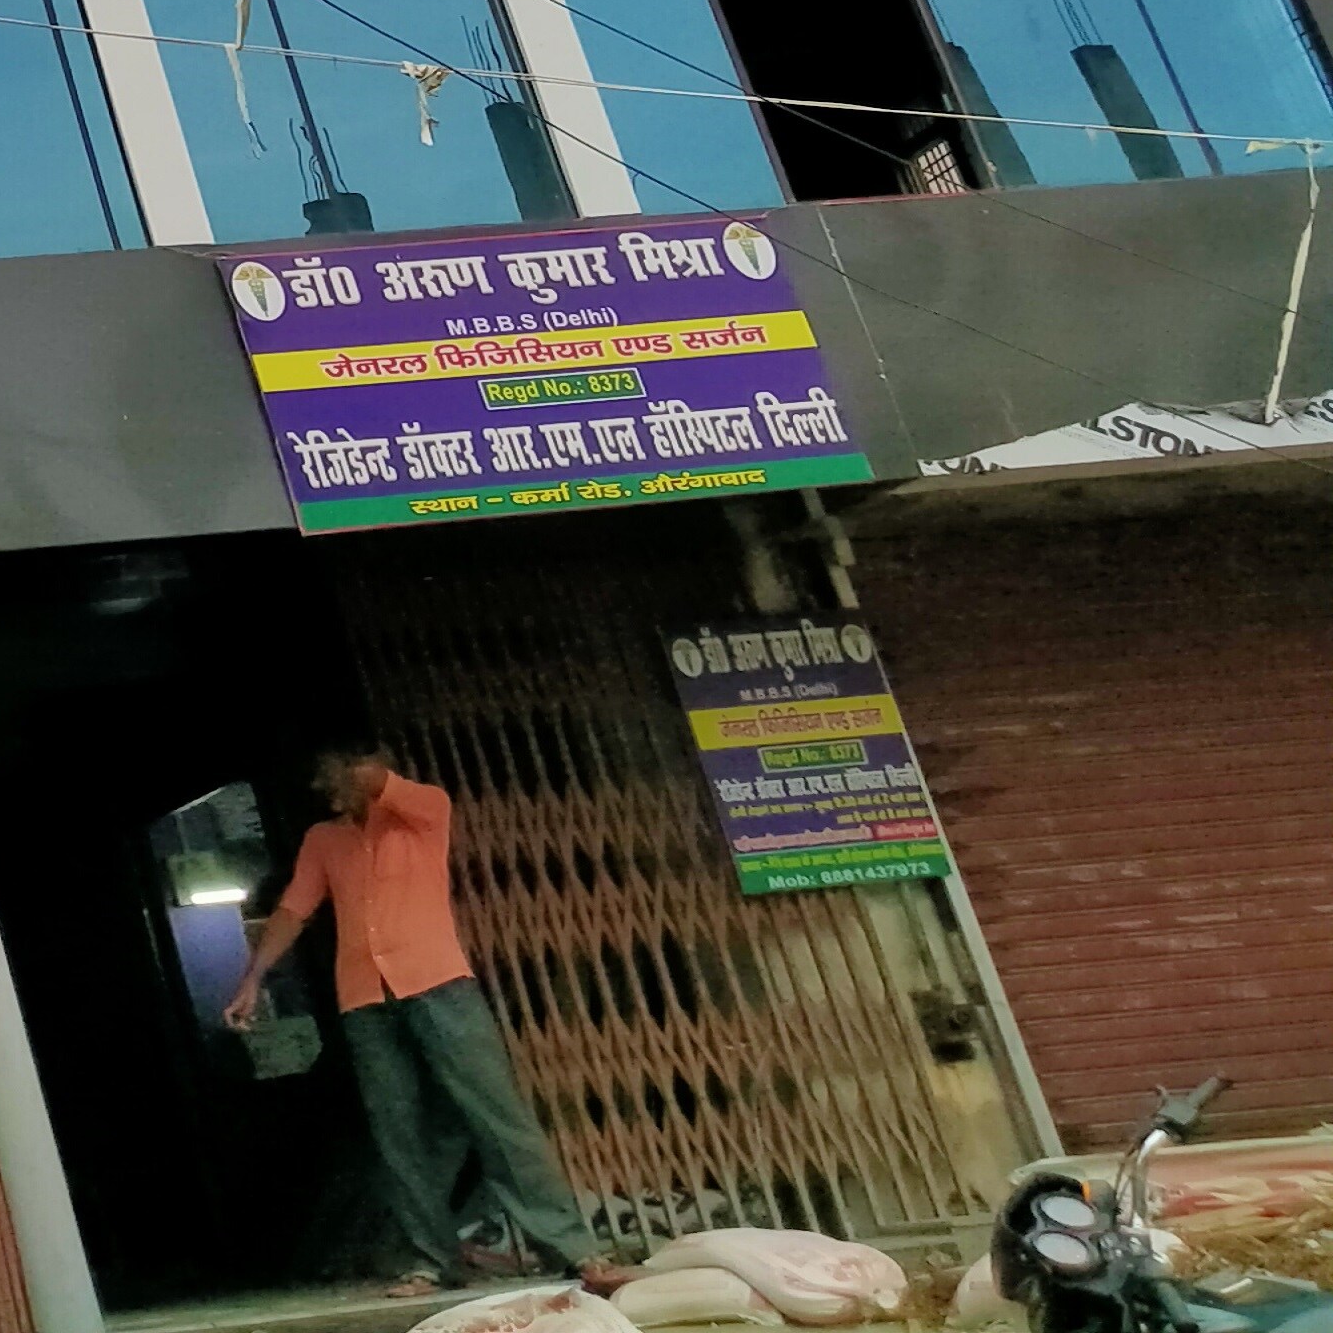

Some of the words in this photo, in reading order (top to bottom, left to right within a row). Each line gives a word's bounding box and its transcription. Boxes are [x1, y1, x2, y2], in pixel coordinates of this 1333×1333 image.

[498, 246, 615, 304] कुमार
[619, 232, 724, 281] मिश्रा
[445, 314, 537, 335] M.B.B.S
[544, 306, 618, 332] (Delhi)
[321, 354, 427, 378] जेनरल
[435, 338, 602, 370] फिजिसियन
[612, 334, 673, 354] एण्ड
[680, 321, 766, 348] सर्जन
[485, 380, 539, 403] Regd
[588, 372, 635, 393] 8373
[396, 422, 482, 480] डॉक्टर
[642, 399, 762, 458] हॉस्पिटल
[754, 387, 848, 448] दिल्ली
[409, 496, 479, 514] स्थान
[512, 481, 570, 506] कर्मा
[641, 469, 766, 494] औरंगाबाद
